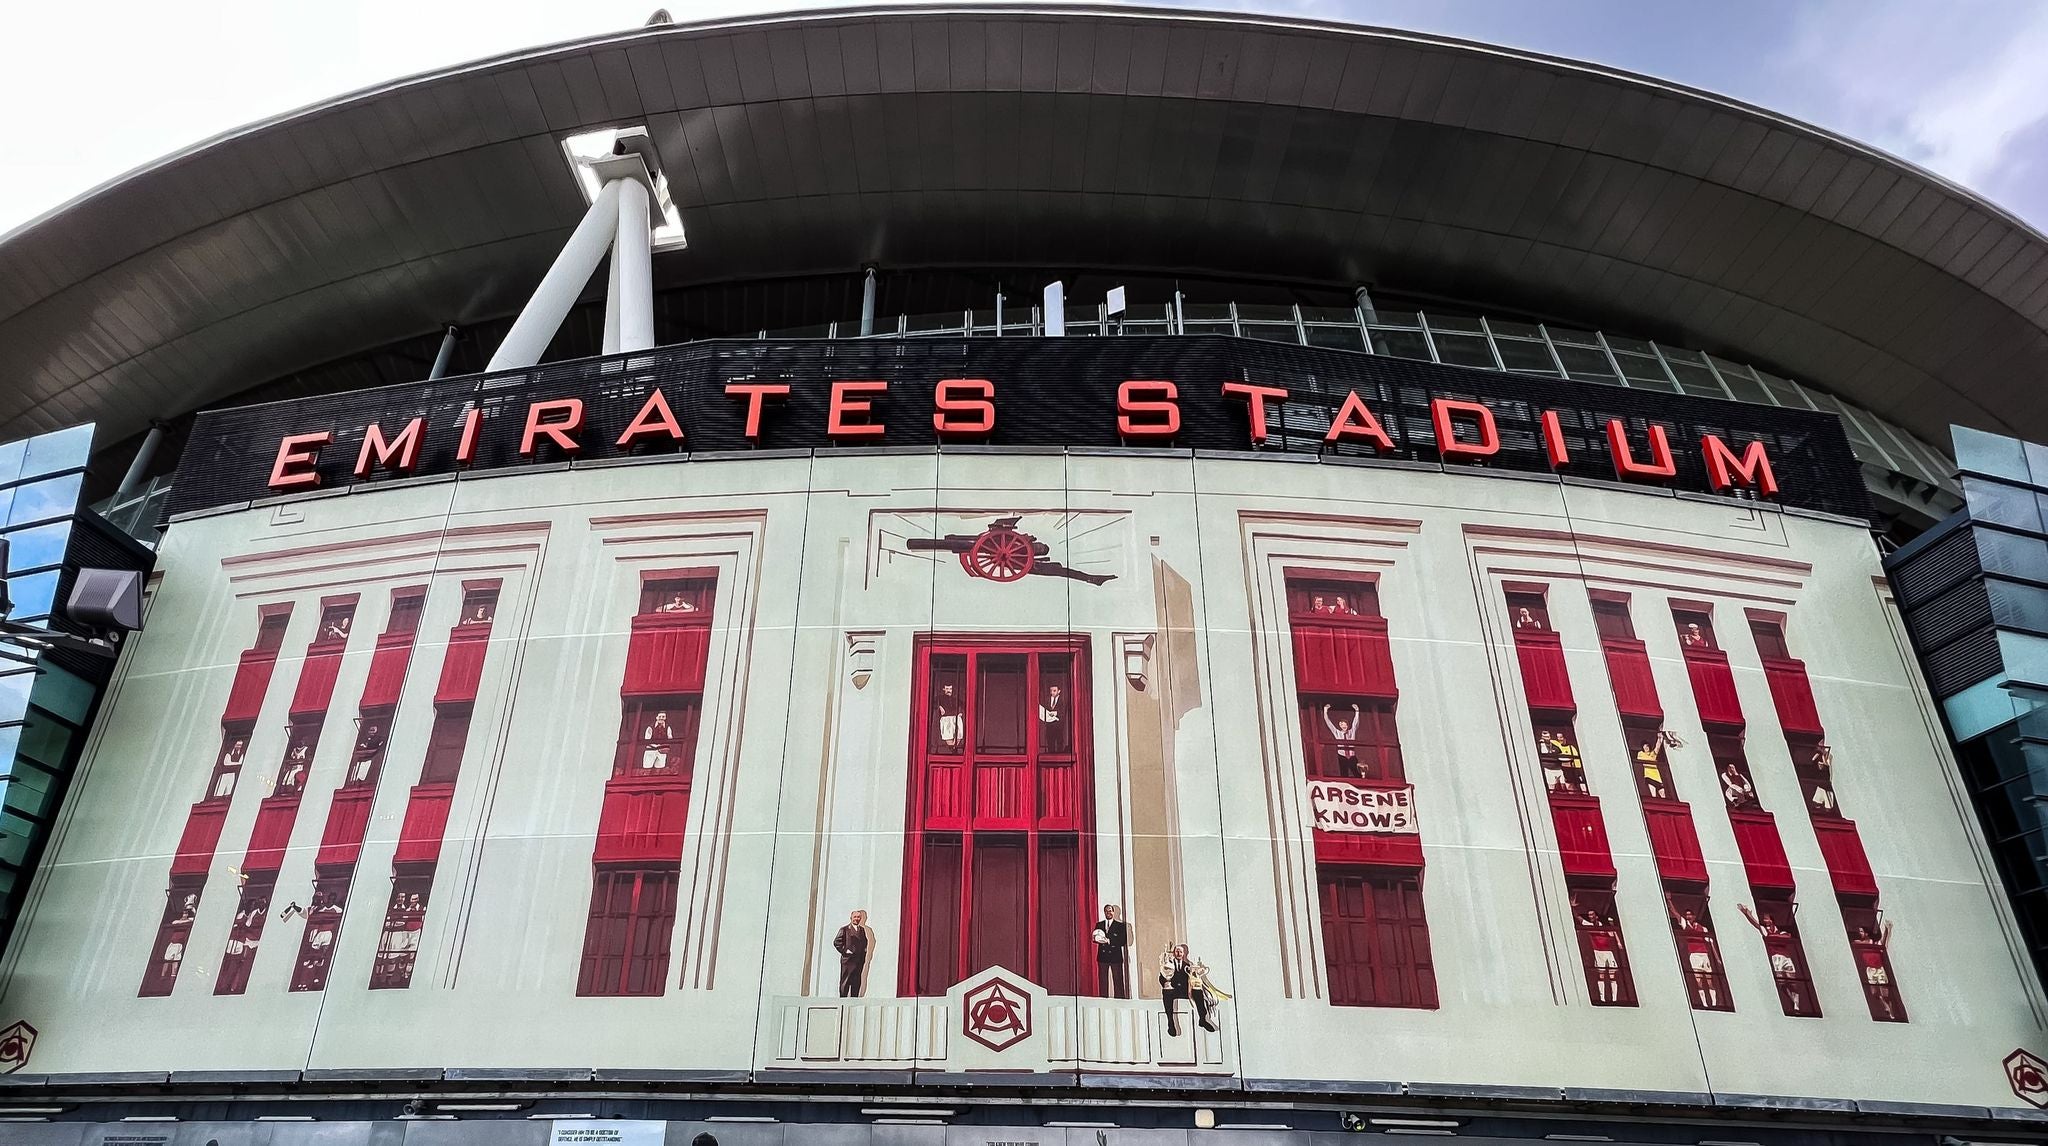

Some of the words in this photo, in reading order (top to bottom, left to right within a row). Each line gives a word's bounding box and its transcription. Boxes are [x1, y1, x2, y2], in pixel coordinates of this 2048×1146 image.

[267, 378, 996, 489] EMIRATES
[1116, 379, 1779, 496] STADIUM
[1310, 785, 1408, 808] ARSENE
[1313, 808, 1407, 827] KNOWS
